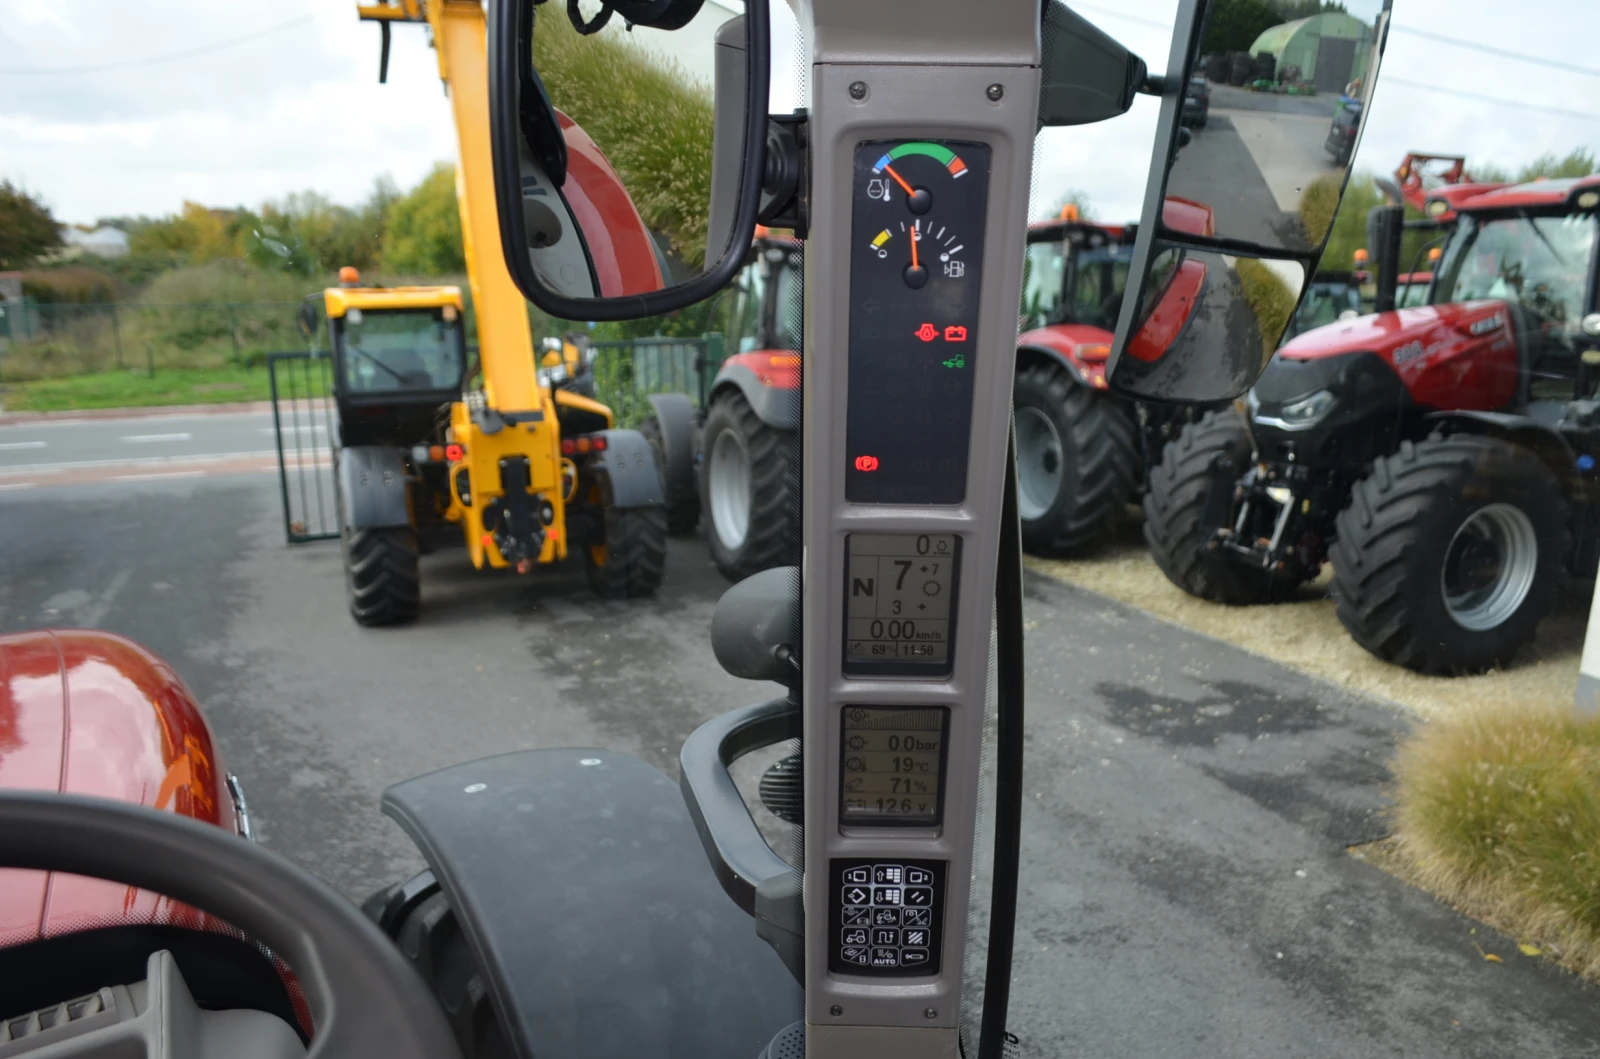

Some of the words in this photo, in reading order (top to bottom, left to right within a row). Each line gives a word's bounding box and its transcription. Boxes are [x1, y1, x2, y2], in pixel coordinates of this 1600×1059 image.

[916, 534, 930, 555] 0
[894, 560, 912, 591] 7
[932, 564, 939, 575] 7
[853, 578, 874, 597] N
[892, 600, 902, 615] 3
[870, 620, 915, 640] 0.00
[888, 735, 915, 752] 0.0
[915, 741, 938, 751] bar
[892, 757, 914, 772] 19
[890, 778, 912, 793] 71
